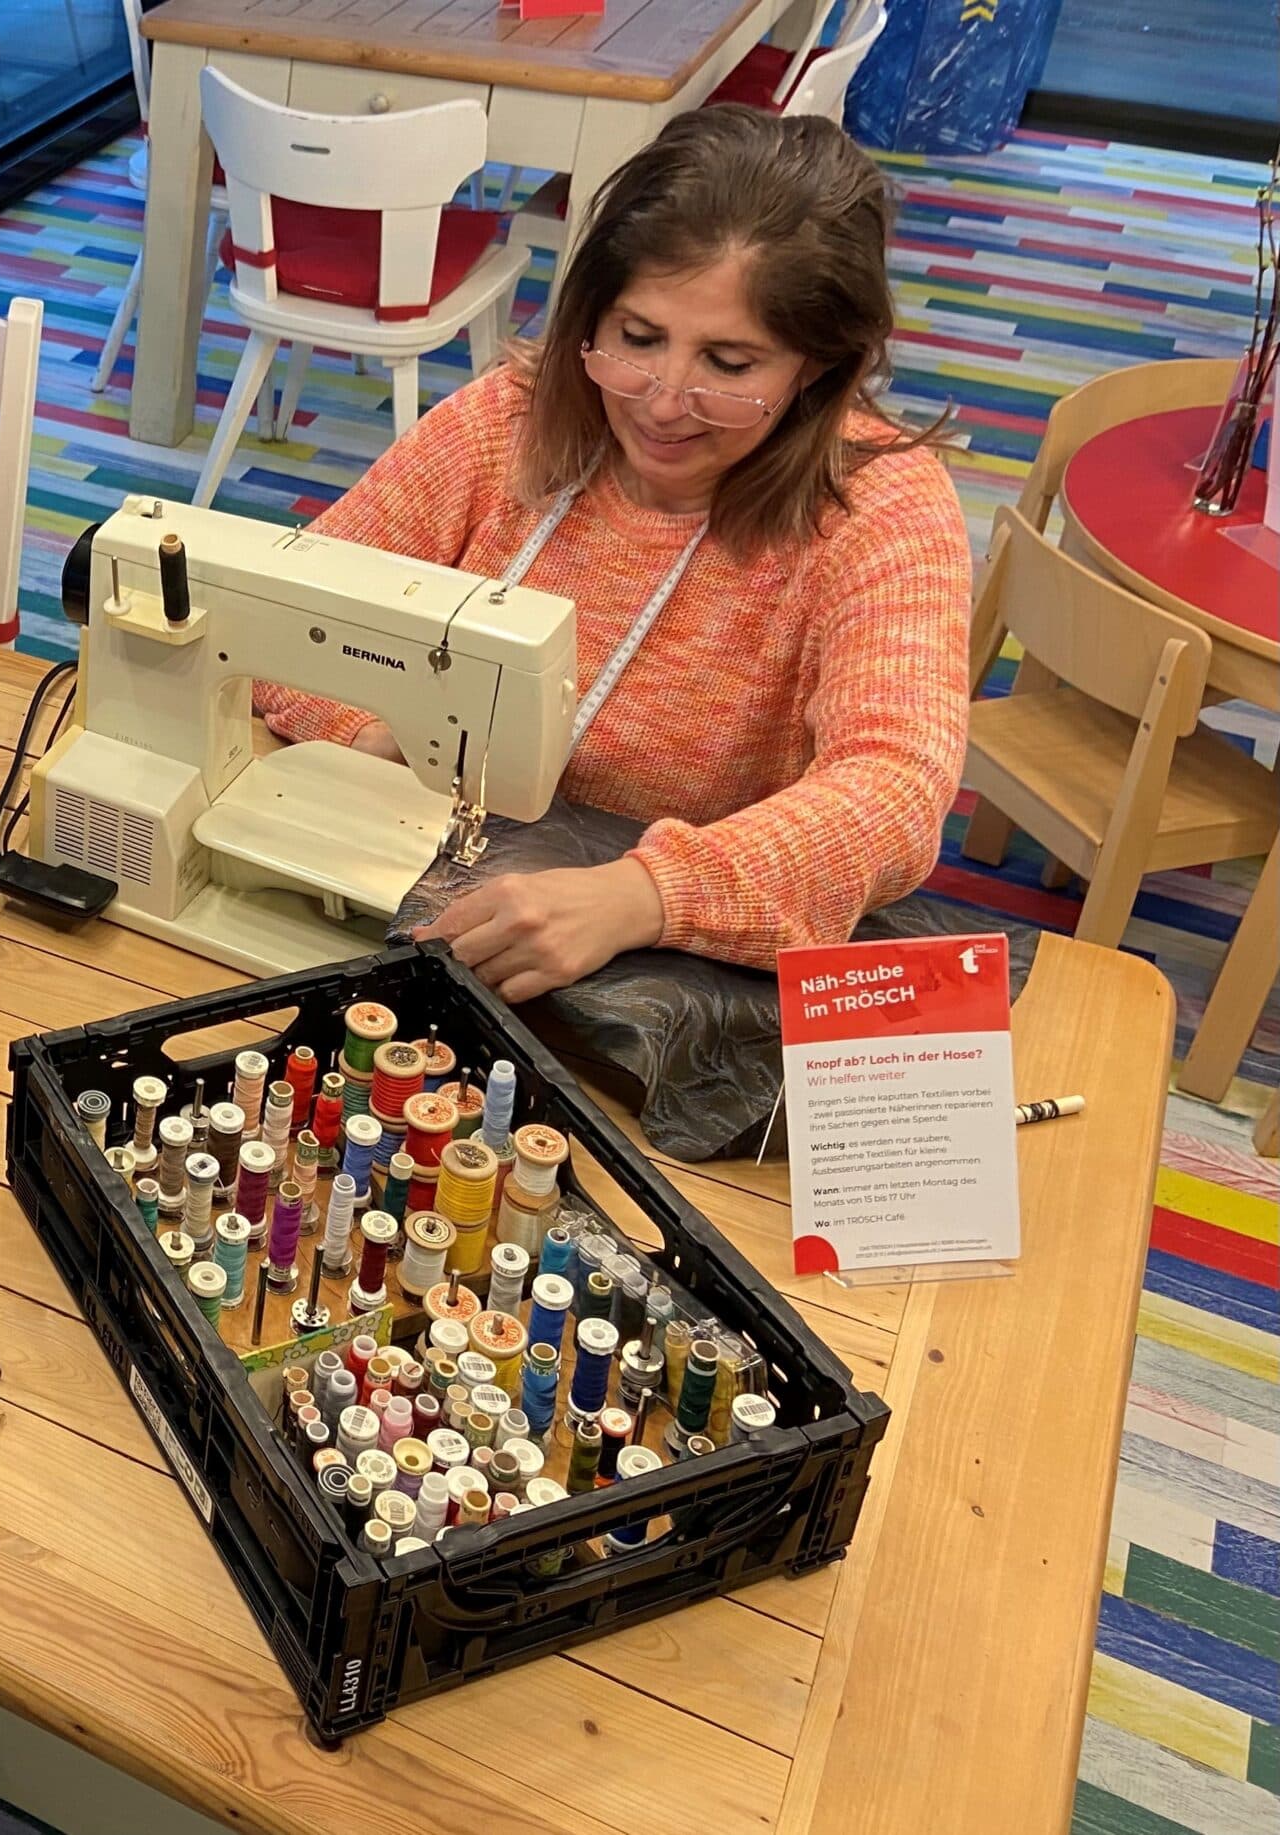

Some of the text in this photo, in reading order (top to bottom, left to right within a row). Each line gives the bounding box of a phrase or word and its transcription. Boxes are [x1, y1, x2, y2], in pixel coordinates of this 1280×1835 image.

[343, 645, 405, 671] BERNINA
[801, 964, 904, 994] Näh-Stube
[803, 985, 915, 1019] im TRÖSCH
[807, 1049, 983, 1071] Knopf ab? Loch in der Hose?
[807, 1070, 906, 1087] Wir helfen weiter
[808, 1099, 842, 1110] Bringen
[858, 1095, 875, 1103] Ihre
[878, 1093, 919, 1104] kaputten
[921, 1090, 960, 1099] Textilien
[814, 1111, 833, 1119] zwei
[835, 1106, 886, 1118] passionierte
[944, 1101, 993, 1111] reparieren
[810, 1124, 826, 1132] Ihre
[828, 1121, 859, 1130] Sachen
[861, 1119, 889, 1128] gegen
[860, 1137, 894, 1147] werden
[913, 1134, 952, 1143] saubere,
[866, 1149, 903, 1158] Textilien
[842, 1184, 872, 1193] immer
[890, 1180, 921, 1189] letzten
[923, 1177, 958, 1188] Montag
[960, 1177, 977, 1185] des
[814, 1198, 845, 1208] Monats
[864, 1195, 873, 1203] 15
[874, 1194, 887, 1202] bis
[833, 1218, 845, 1226] im
[339, 1660, 362, 1712] LL4310
